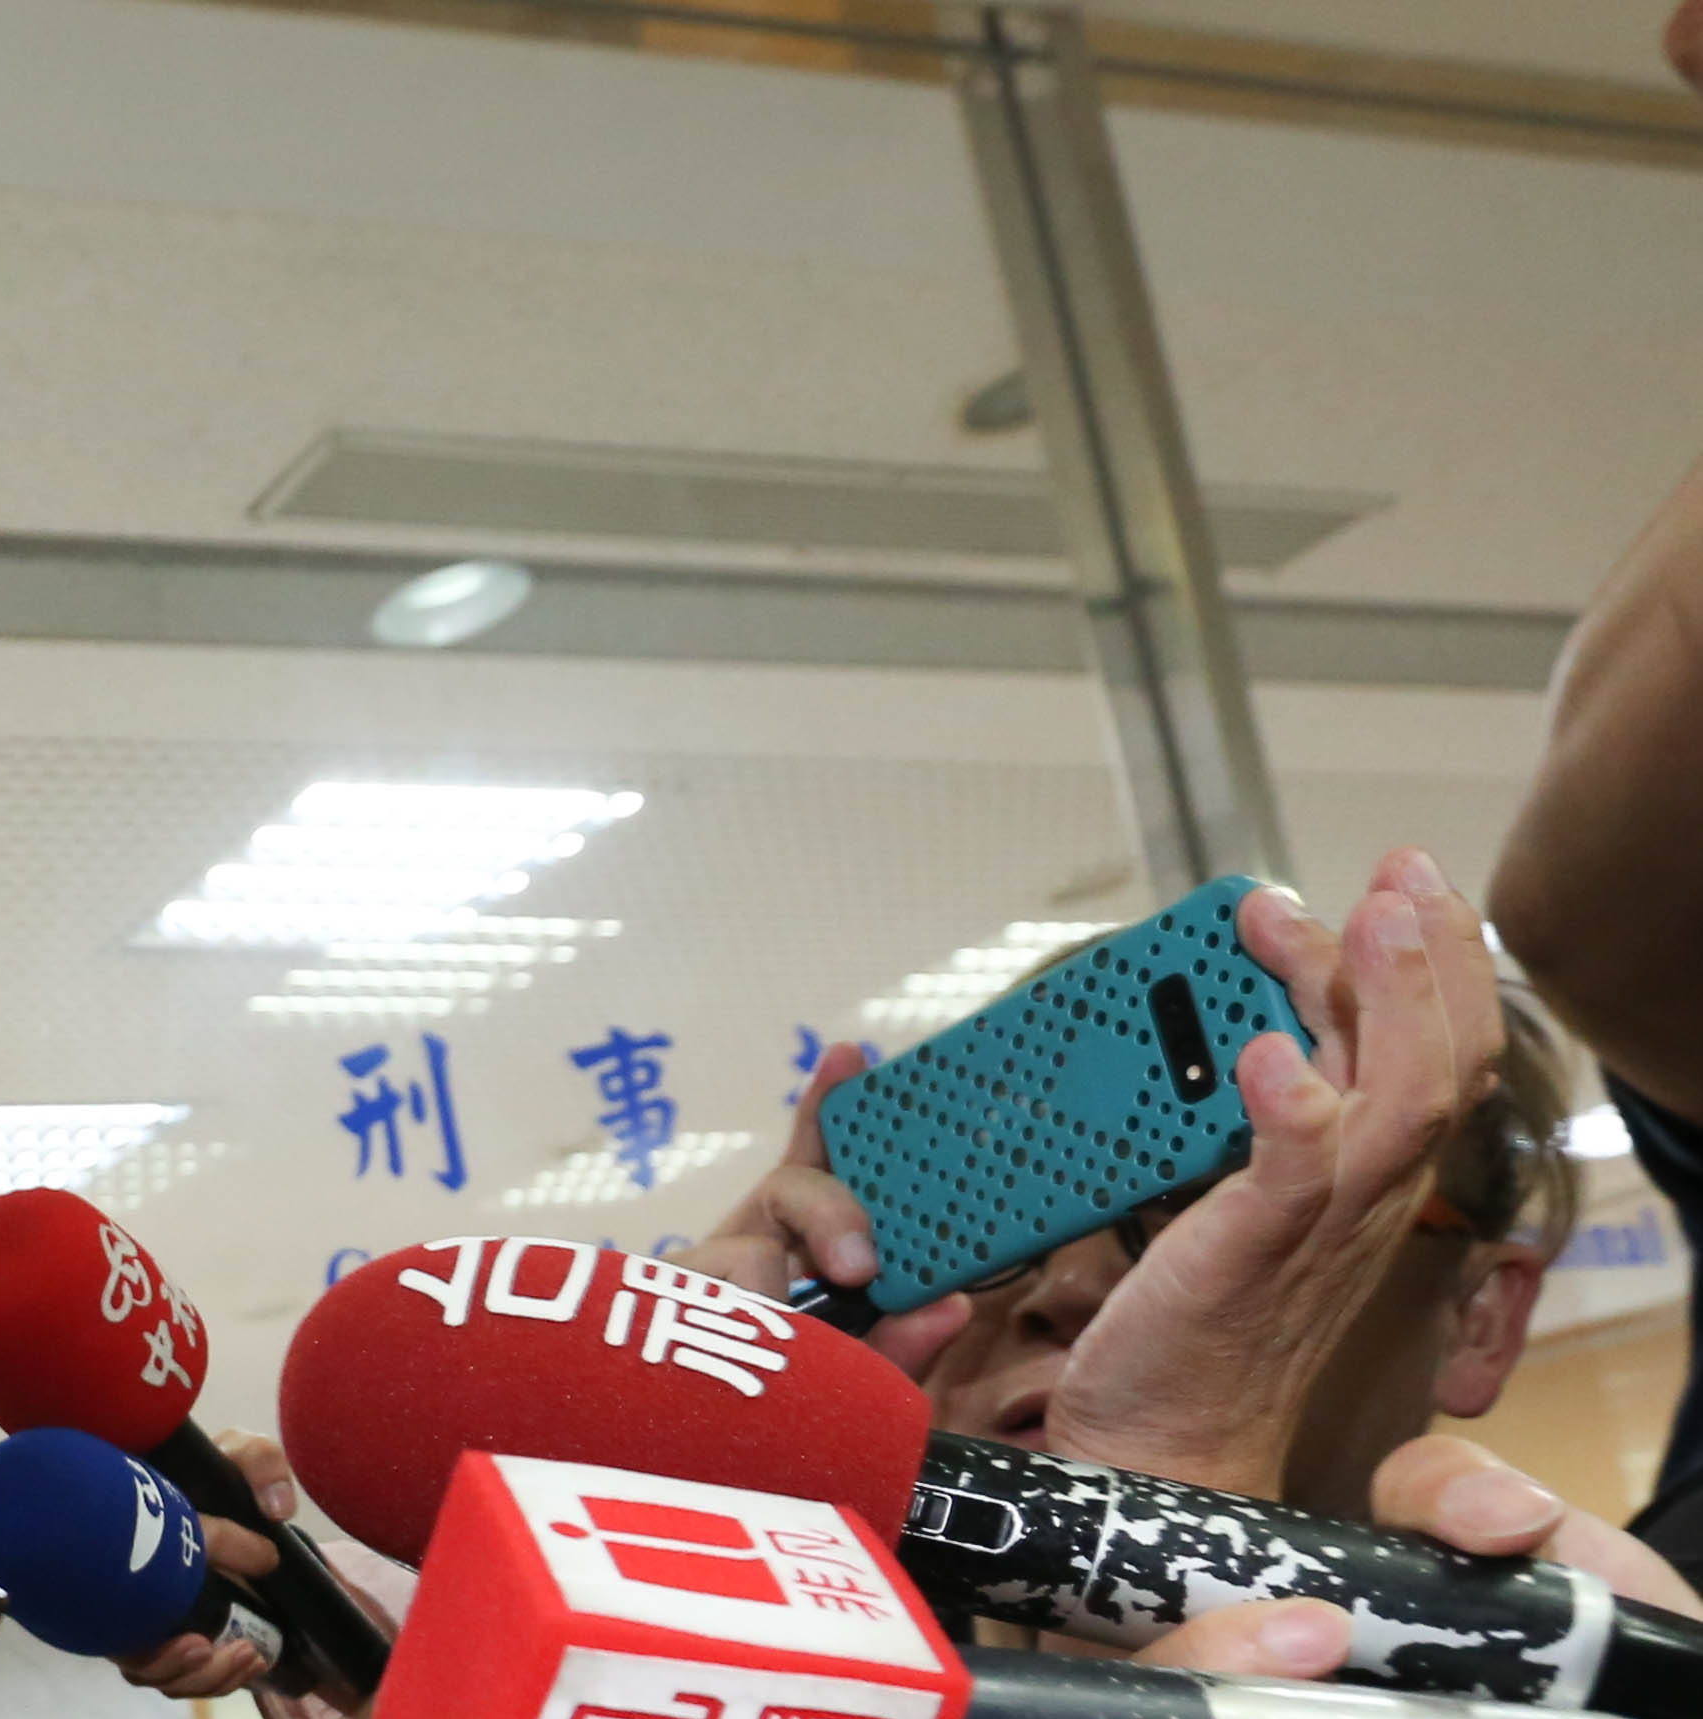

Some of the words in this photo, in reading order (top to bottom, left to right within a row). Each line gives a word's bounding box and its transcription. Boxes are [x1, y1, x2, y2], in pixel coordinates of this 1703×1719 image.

[338, 1026, 861, 1193] 刑事
[396, 1236, 796, 1399] 台視
[765, 1529, 892, 1621] 非凡
